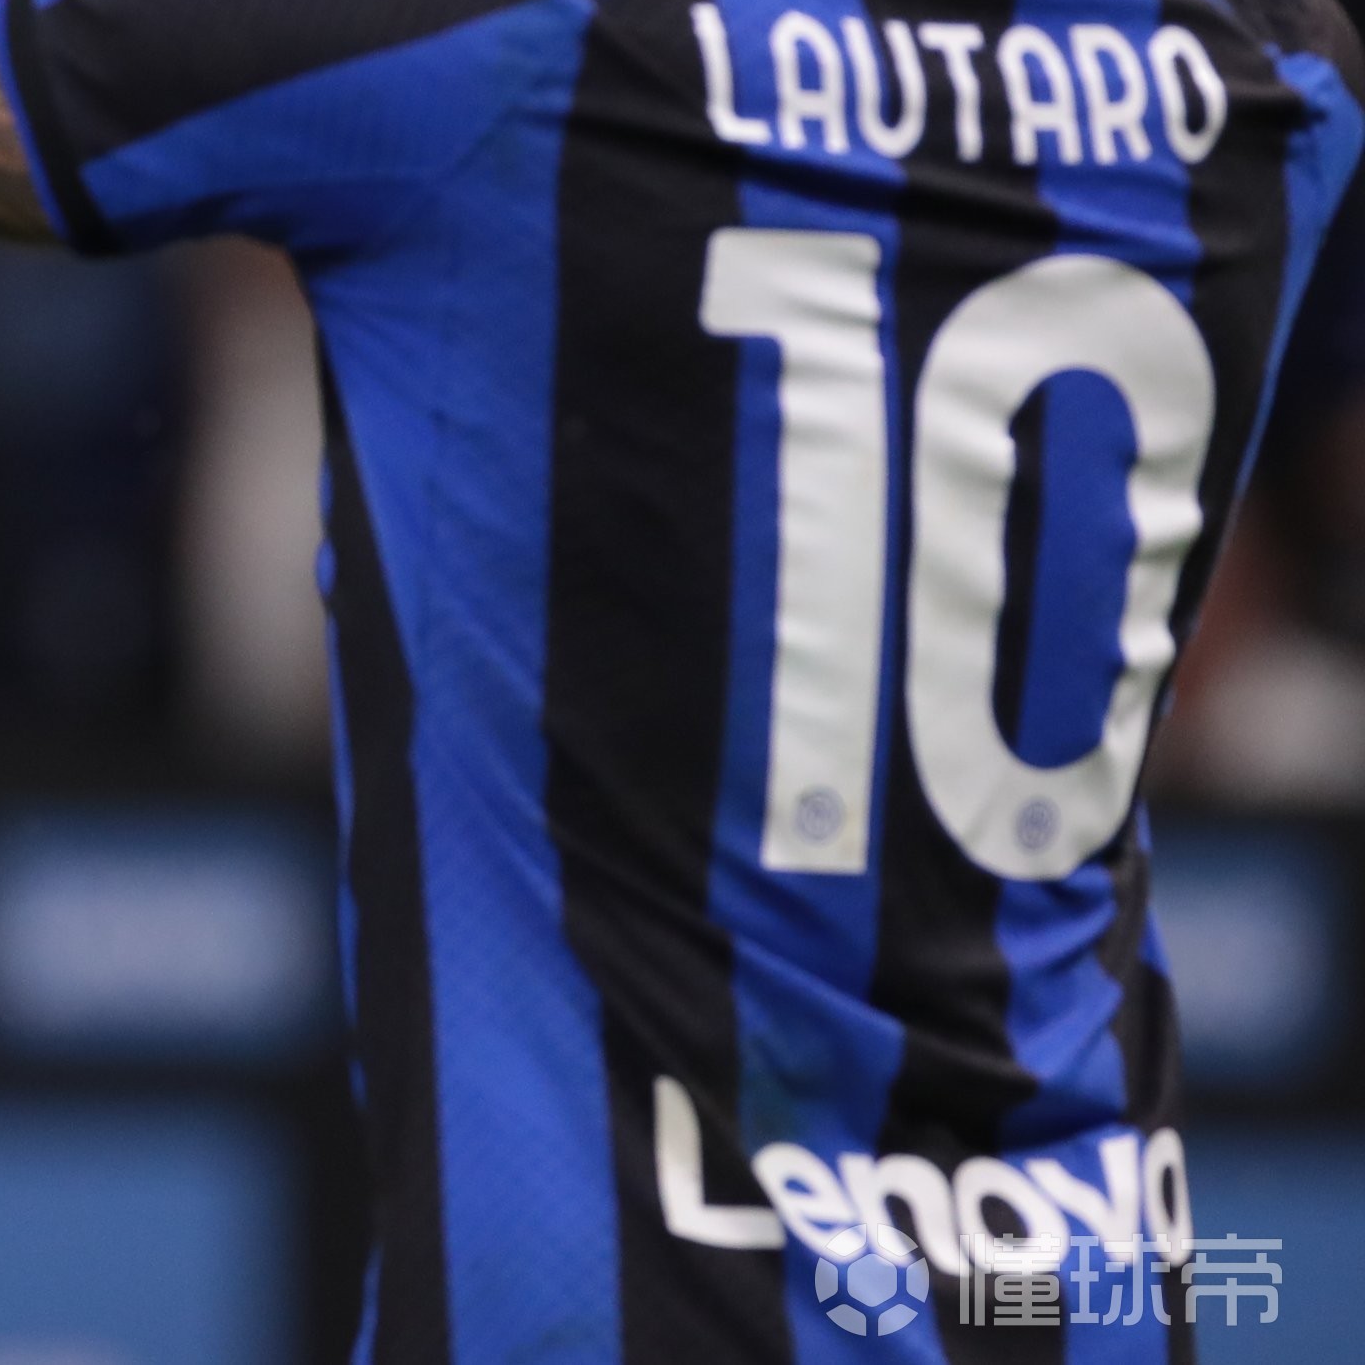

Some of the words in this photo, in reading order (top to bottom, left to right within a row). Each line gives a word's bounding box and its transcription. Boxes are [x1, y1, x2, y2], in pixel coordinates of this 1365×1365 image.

[689, 1, 1228, 166] LAUTARO
[699, 226, 1217, 882] 10
[653, 1073, 1194, 1276] Lenovo
